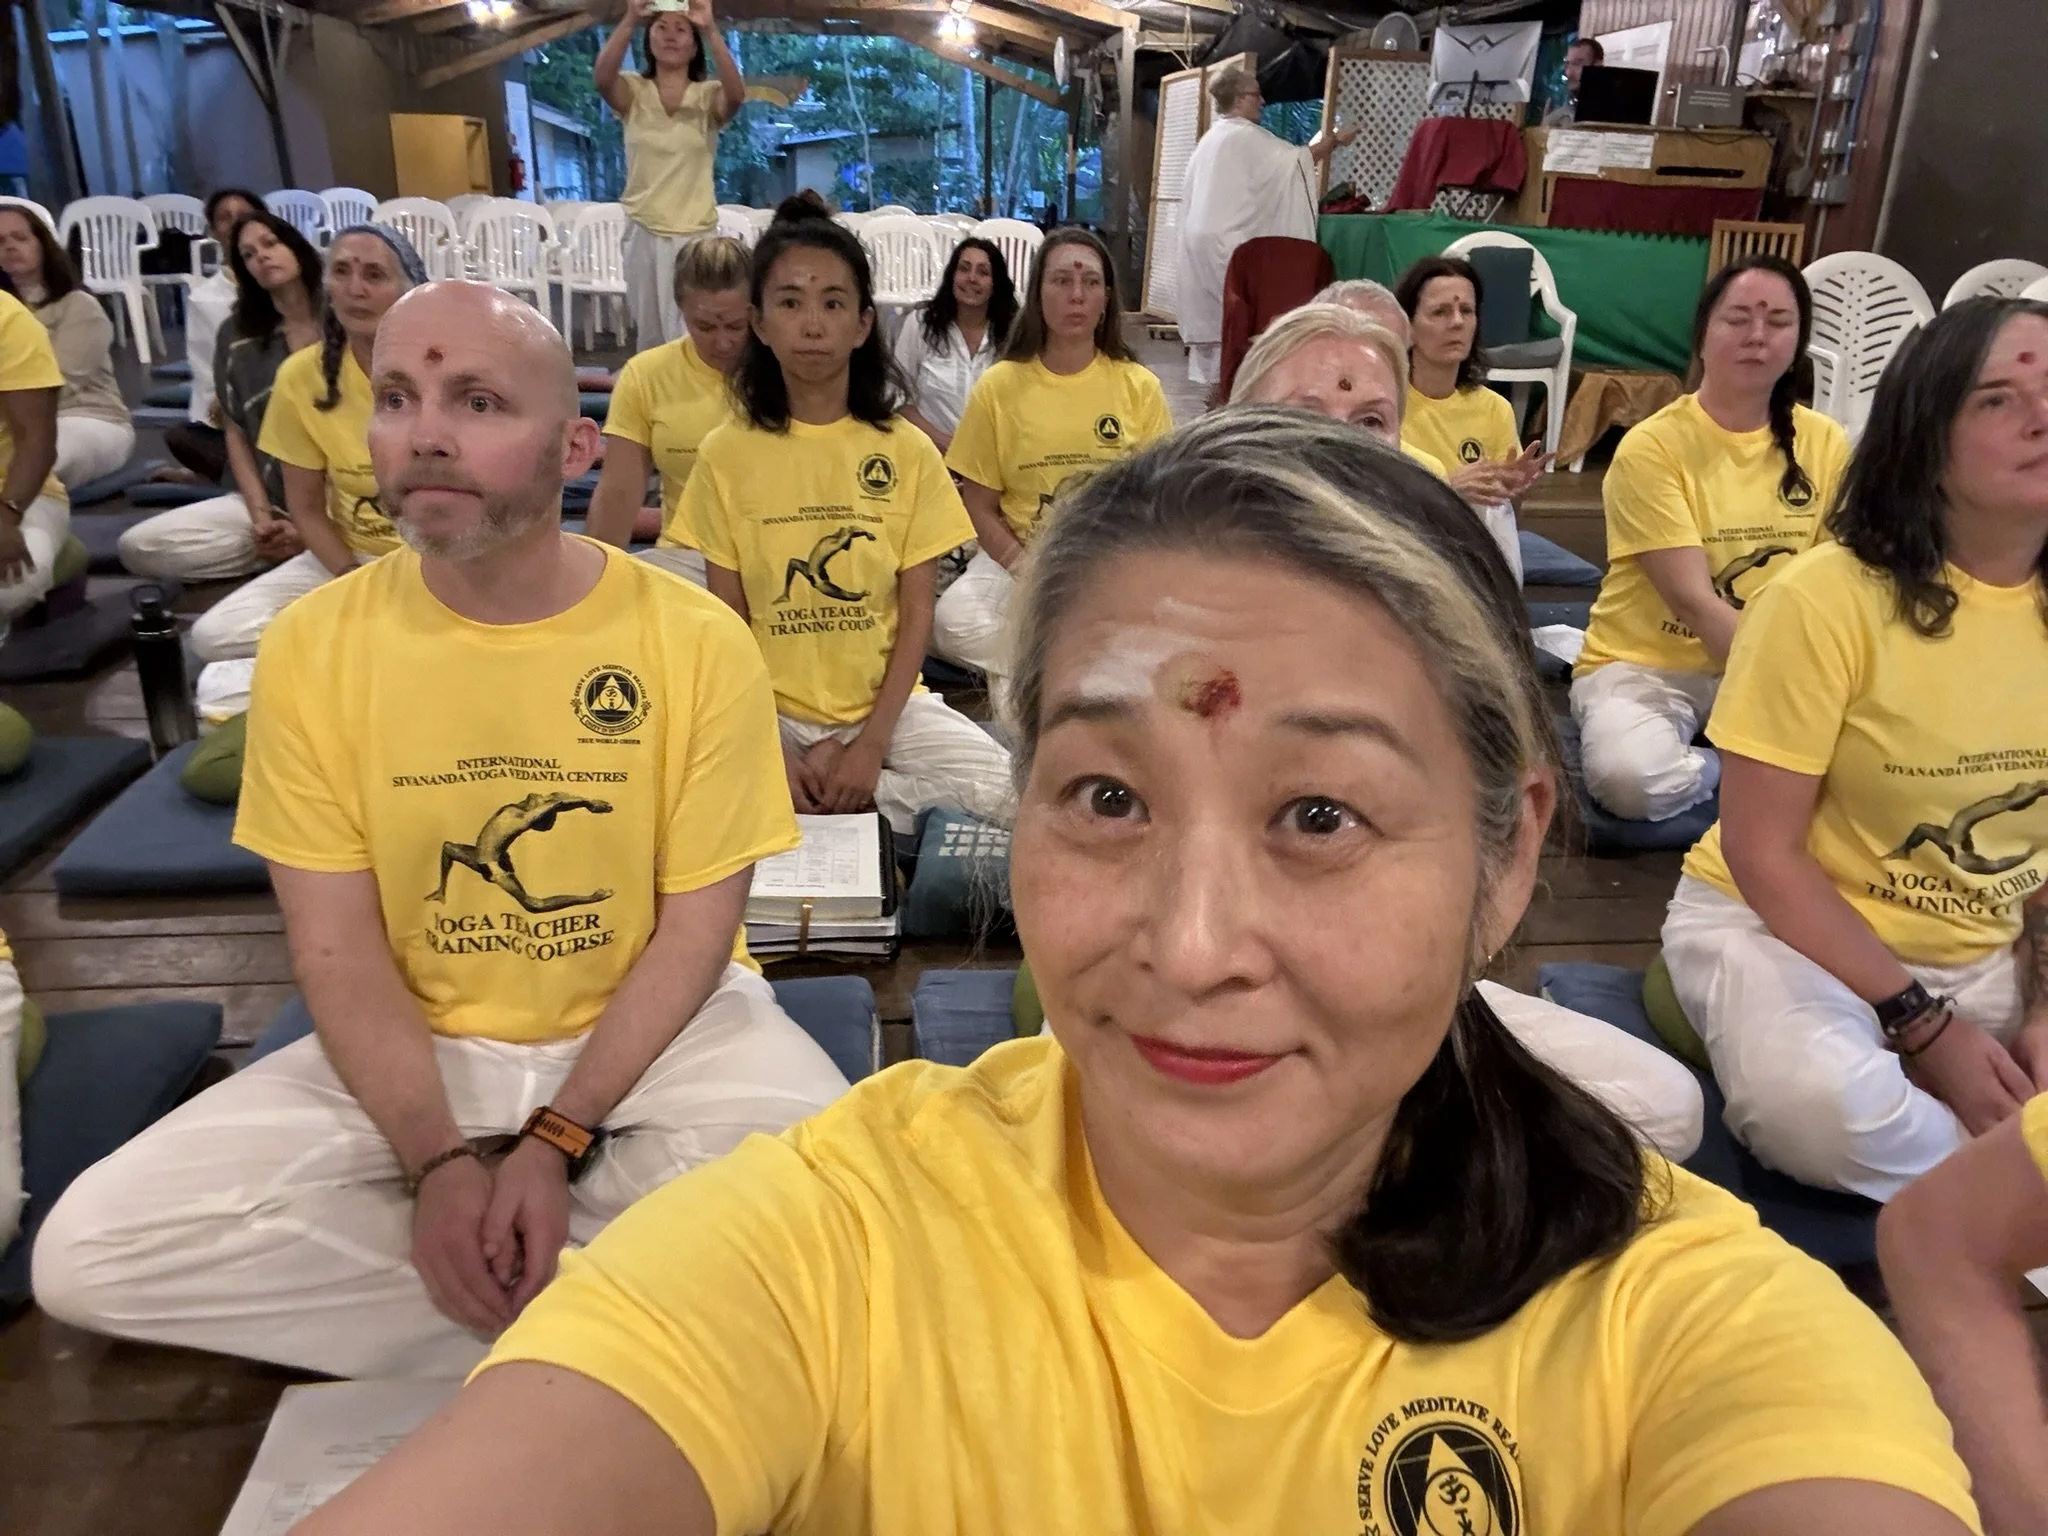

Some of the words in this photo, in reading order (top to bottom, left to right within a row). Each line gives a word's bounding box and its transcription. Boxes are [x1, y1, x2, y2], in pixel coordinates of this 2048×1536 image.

[777, 608, 818, 622] YOGA
[819, 606, 866, 618] TEACH
[768, 621, 834, 636] TRAINING
[456, 756, 562, 770] INTERNATIONAL
[1958, 747, 2048, 765] INTERNATIONAL
[392, 773, 467, 787] SIVANANDA
[468, 768, 508, 781] YOGA
[507, 767, 565, 782] VEDANTA
[566, 771, 629, 783] CENTRES
[1882, 763, 1962, 778] SIVANANDA
[1963, 762, 1995, 775] YOGA
[1887, 871, 1954, 893] YOGA
[1865, 881, 1984, 915] TRAINING
[500, 912, 601, 939] TEACHER
[524, 929, 616, 962] COURSE
[1400, 1396, 1490, 1424] MEDITATE
[1365, 1412, 1401, 1458] LOVE
[1357, 1457, 1375, 1521] SERVE
